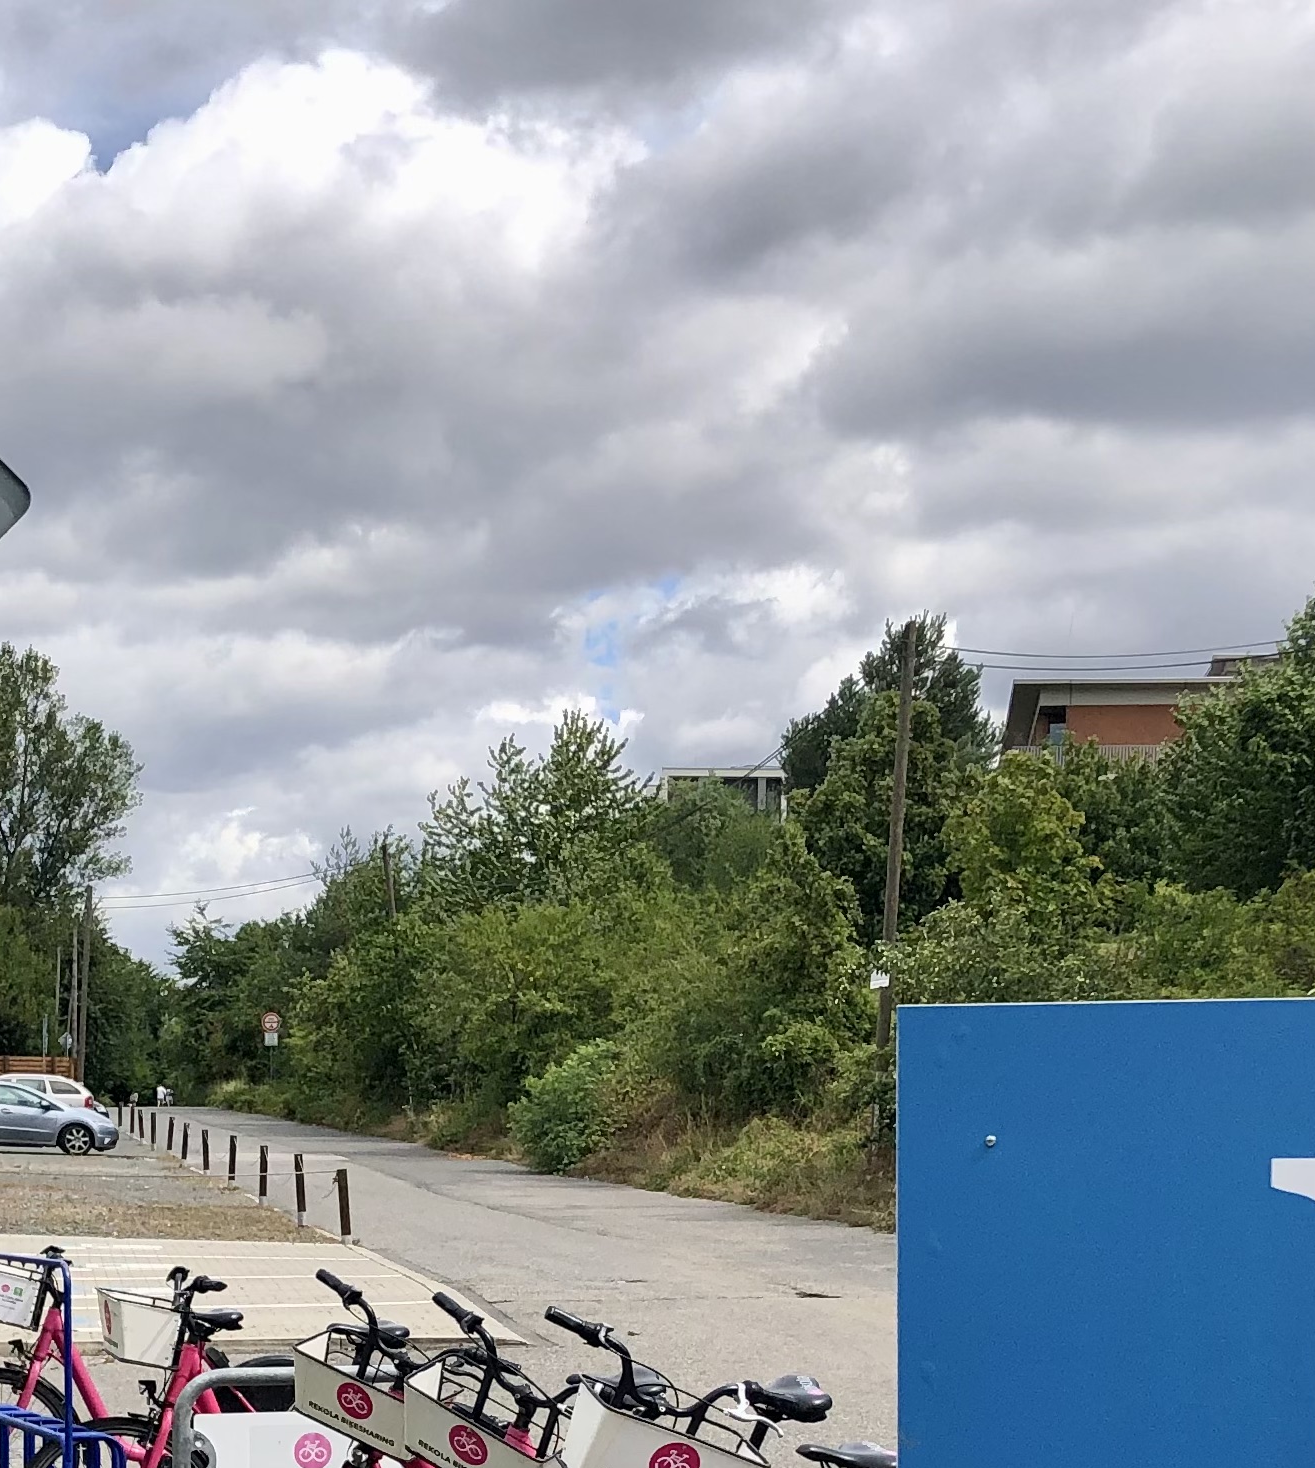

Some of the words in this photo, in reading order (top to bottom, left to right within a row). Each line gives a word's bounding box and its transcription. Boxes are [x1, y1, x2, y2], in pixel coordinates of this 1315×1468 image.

[308, 1400, 340, 1421] REKOLA
[340, 1415, 395, 1448] BIKESHARING
[417, 1438, 451, 1465] REKOLA
